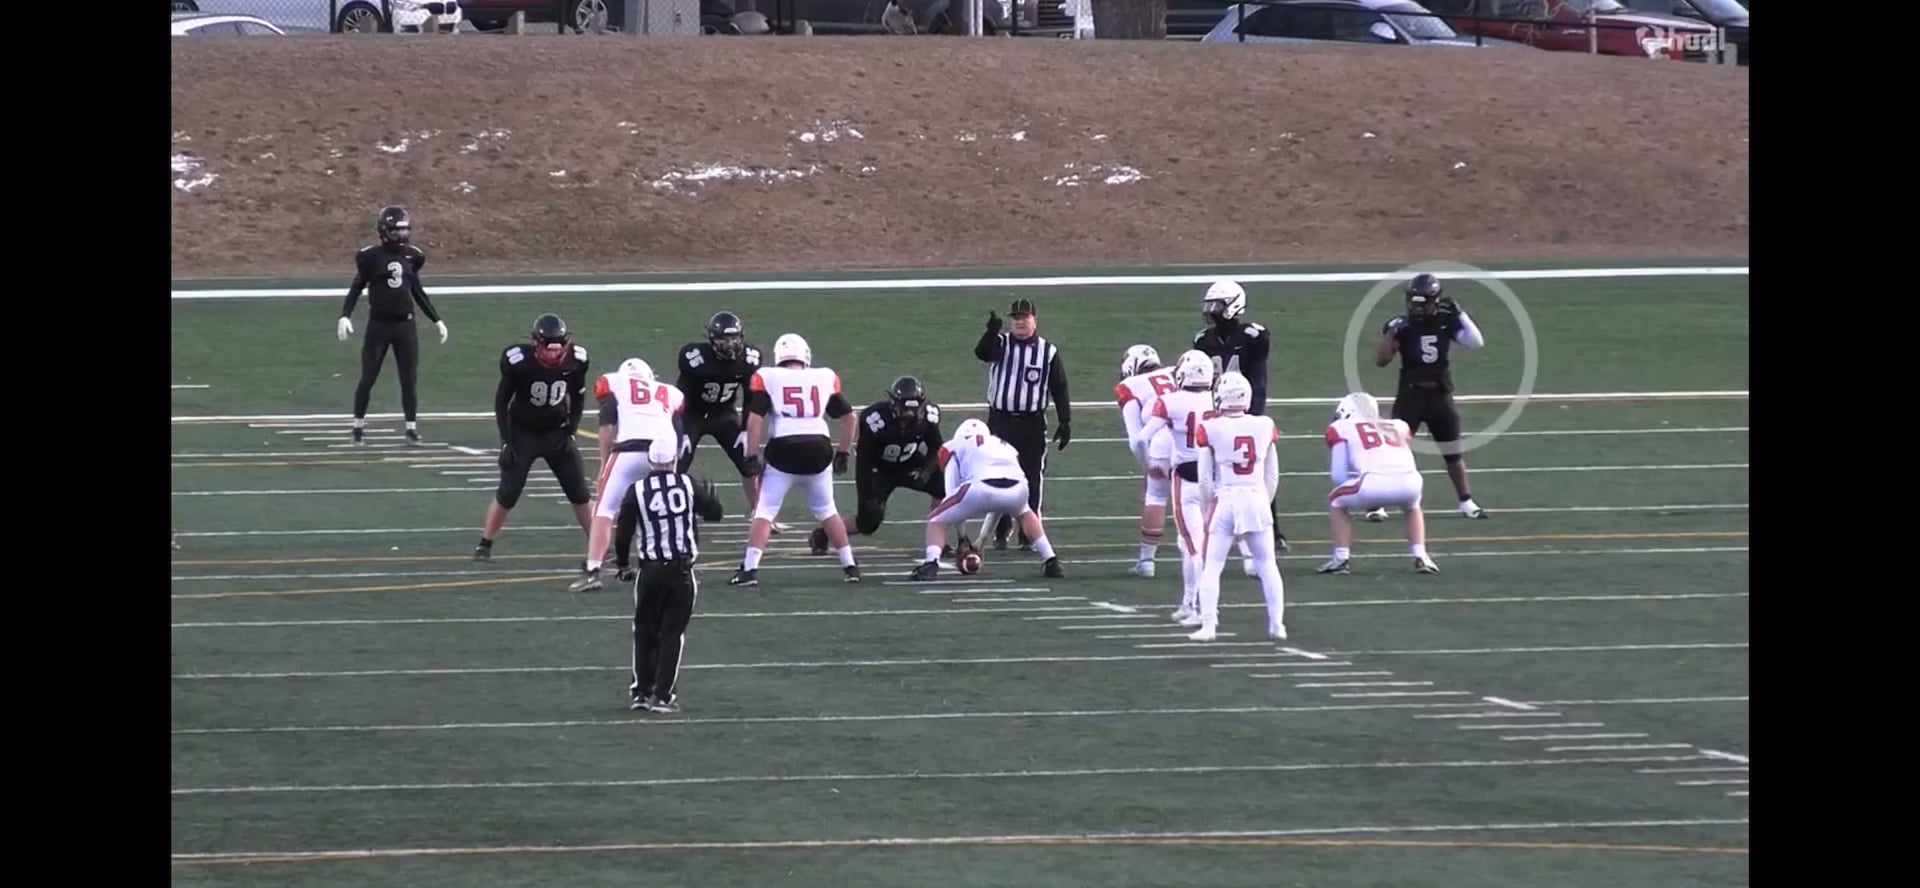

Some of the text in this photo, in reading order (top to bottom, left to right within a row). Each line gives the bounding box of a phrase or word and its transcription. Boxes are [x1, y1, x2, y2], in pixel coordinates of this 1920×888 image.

[387, 261, 403, 288] 3
[1420, 335, 1438, 363] 5
[529, 380, 567, 406] 90
[630, 378, 669, 413] 64
[701, 382, 738, 403] 35
[781, 385, 821, 418] 51
[1355, 422, 1402, 449] 65
[1233, 436, 1255, 475] 3
[649, 487, 687, 516] 40
